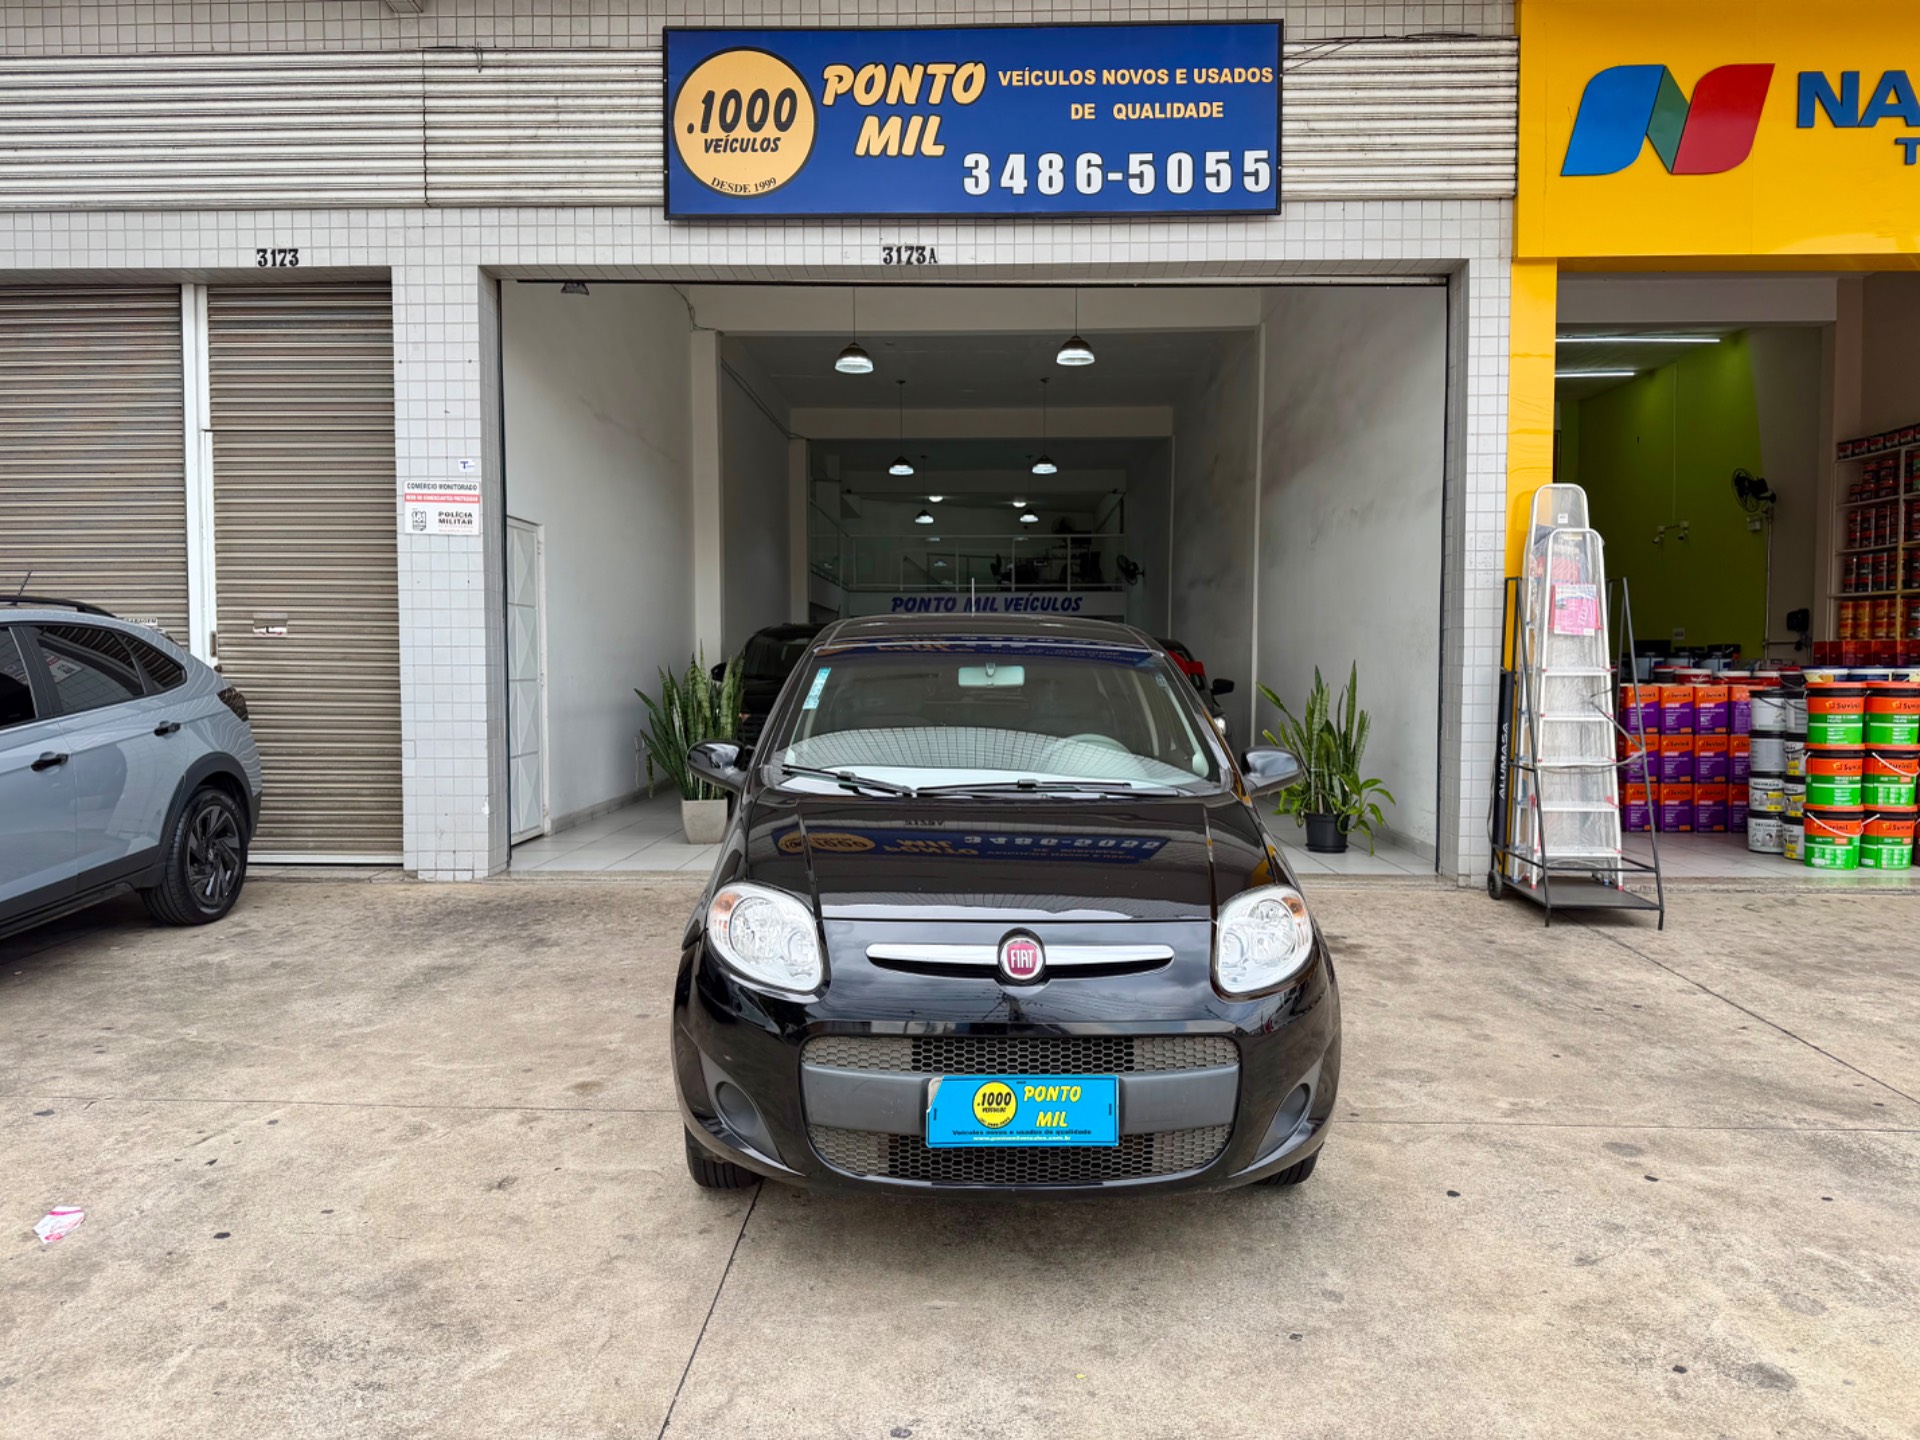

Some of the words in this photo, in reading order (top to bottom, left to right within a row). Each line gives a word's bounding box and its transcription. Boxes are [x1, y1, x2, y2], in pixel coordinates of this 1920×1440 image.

[822, 62, 987, 106] PONTO
[998, 67, 1096, 86] VEÍCULOS
[1102, 70, 1169, 85] NOVOS
[1175, 69, 1188, 84] E
[1193, 67, 1274, 84] USADOS
[1070, 104, 1096, 120] DE
[1112, 102, 1225, 121] QUALIDADE
[703, 134, 782, 154] VEÍCULOS
[854, 114, 946, 157] MIL
[963, 149, 1272, 197] 3486-5055
[753, 177, 778, 193] 1999
[256, 248, 300, 268] 3173
[882, 245, 938, 266] 3173A
[439, 483, 478, 491] MONITORADO
[437, 510, 473, 519] POLÍCIA
[891, 597, 956, 612] PONTO
[963, 597, 999, 613] MIL
[1004, 592, 1083, 613] VEÍCULOS
[1498, 722, 1509, 801] ALUMASA
[1010, 949, 1035, 969] FIAT
[1023, 1085, 1082, 1102] PONTO
[1036, 1111, 1068, 1127] MIL
[1055, 1128, 1092, 1136] qualidade
